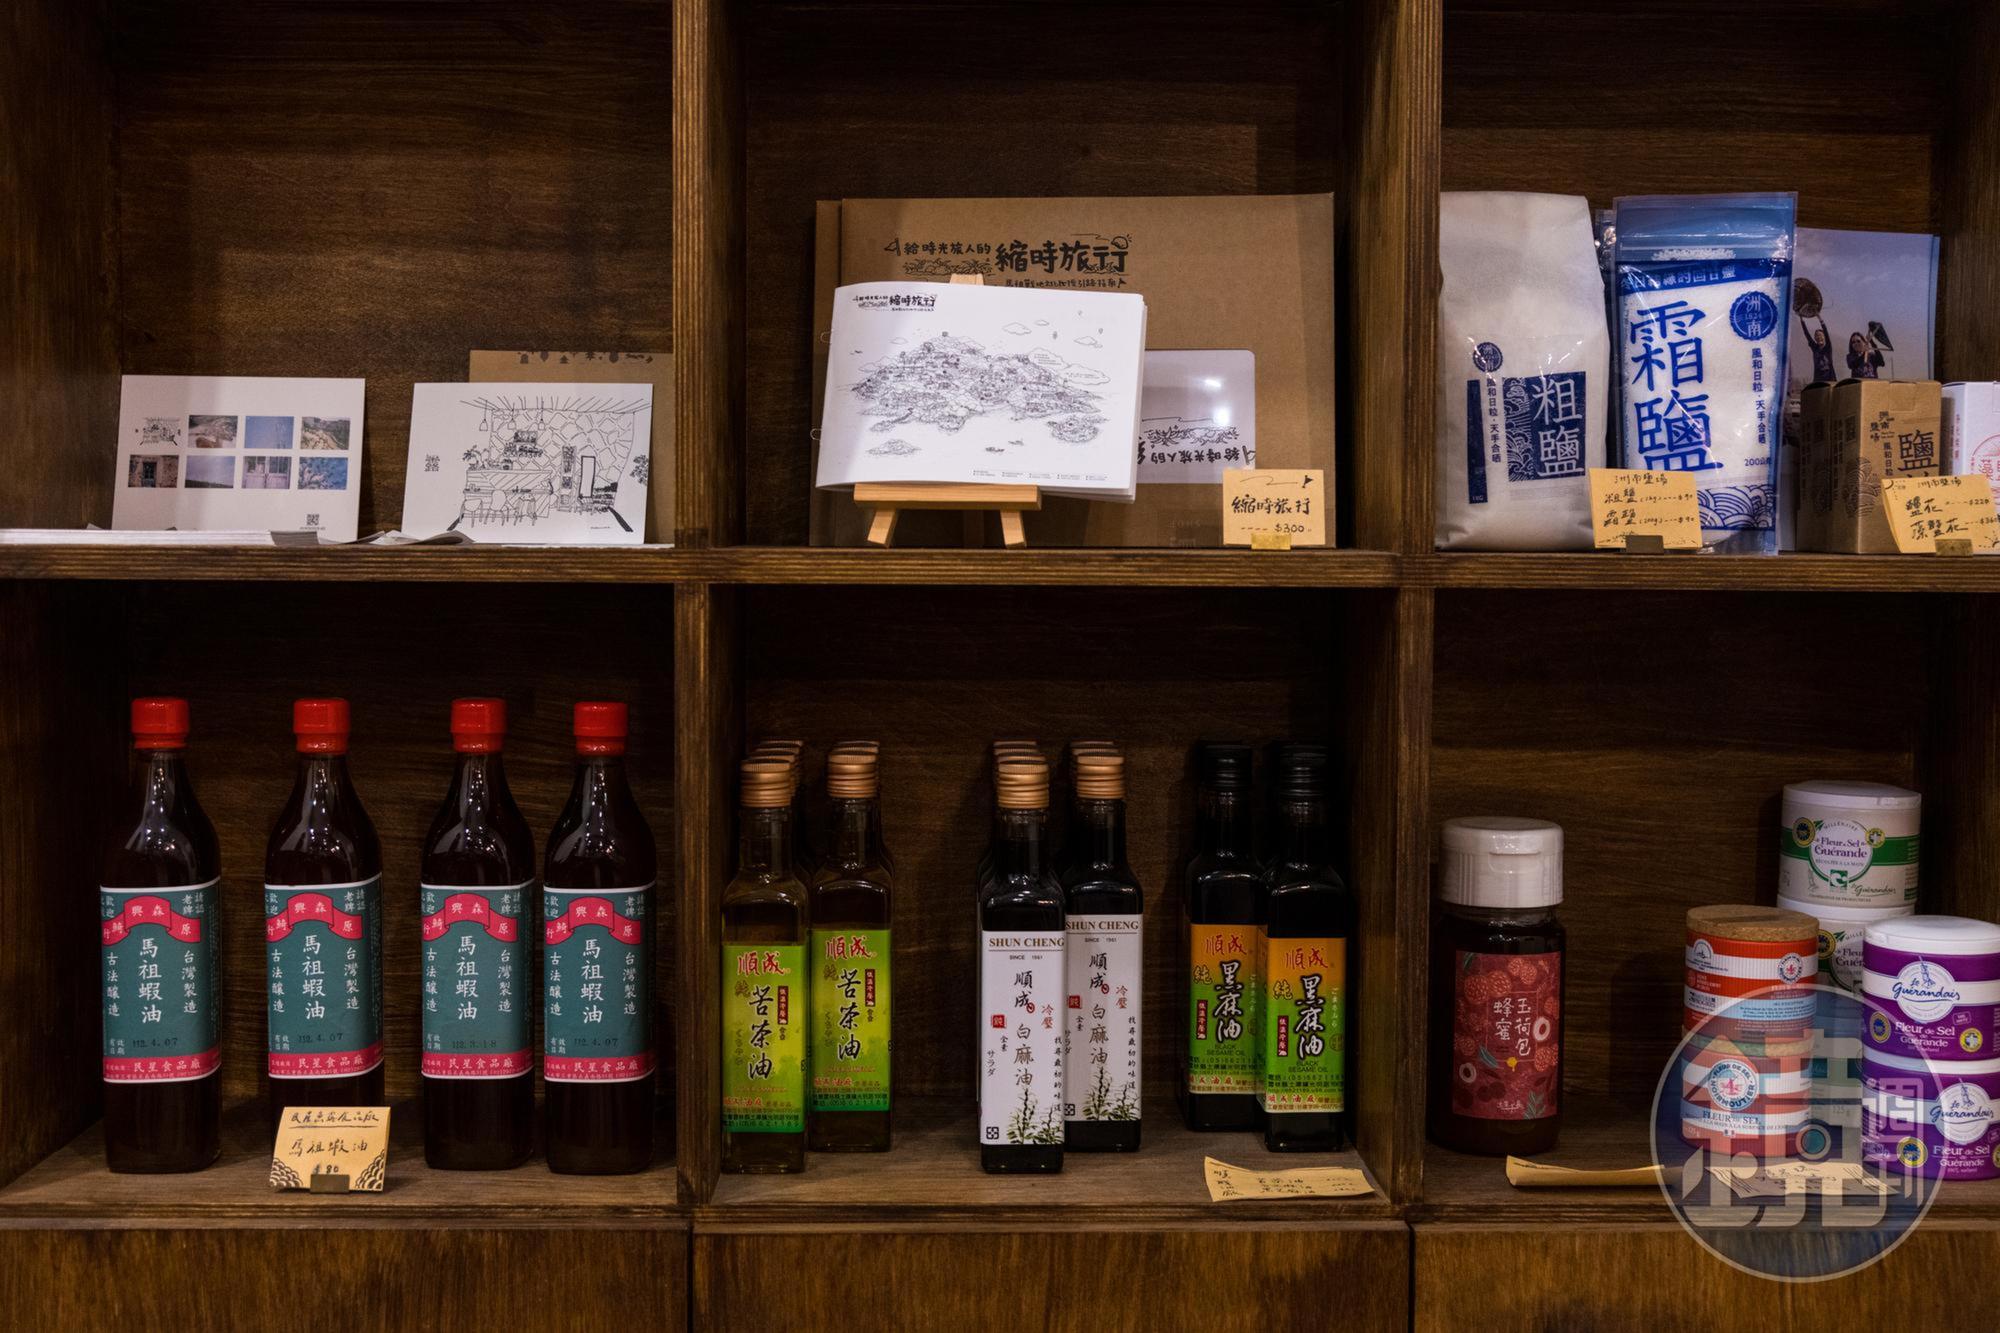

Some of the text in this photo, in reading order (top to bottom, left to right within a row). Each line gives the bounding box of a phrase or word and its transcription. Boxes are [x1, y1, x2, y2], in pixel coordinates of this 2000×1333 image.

[904, 239, 1129, 273] 給時光旅人的 縮時旅行
[1630, 300, 1723, 472] 霜鹽
[1532, 377, 1585, 478] 粗鹽
[1151, 447, 1240, 464] 給時光旅人的
[1897, 430, 1939, 478] 鹽
[1231, 493, 1311, 515] 縮時旅行
[1274, 523, 1305, 533] $300
[1814, 844, 1867, 858] Guérande
[1821, 836, 1860, 848] Fleur Sel
[1066, 920, 1139, 930] SHUN CHENG
[825, 935, 872, 960] 順成
[989, 937, 1065, 948] SHUN CHENG
[1206, 934, 1247, 956] 順成
[1843, 948, 1864, 956] Fleu
[737, 951, 784, 976] 順成
[1089, 952, 1107, 989] 順成
[1285, 947, 1329, 970] 順成
[1835, 955, 1864, 967] Guér
[107, 951, 121, 1018] 古法釀造
[138, 937, 164, 1024] 馬祖蝦油
[181, 949, 199, 1014] 台灣製造
[271, 949, 286, 1013] 古法釀造
[302, 934, 327, 1020] 馬祖蝦油
[344, 946, 360, 1010] 台灣製造
[426, 947, 439, 1013] 古法釀造
[455, 935, 480, 1020] 馬祖蝦油
[497, 949, 513, 1013] 台灣製造
[549, 952, 563, 1017] 古法釀造
[580, 938, 605, 1024] 馬祖蝦油
[622, 952, 638, 1016] 台灣製造
[1193, 963, 1213, 986] 純
[1014, 970, 1033, 1008] 順成
[1116, 985, 1128, 1009] 冷壓
[1213, 960, 1244, 1043] 黑麻油
[1272, 979, 1294, 1001] 純
[1892, 981, 1960, 1001] Guérandais
[837, 968, 861, 1060] 苦茶油
[1041, 1003, 1054, 1029] 冷壓
[1295, 973, 1326, 1061] 黑麻油
[1493, 996, 1515, 1041] 蜂蜜
[1515, 996, 1532, 1056] 玉荷包
[748, 985, 774, 1080] 苦茶油
[1089, 1004, 1109, 1065] 白麻油
[1895, 1021, 1924, 1034] Fleur
[1936, 1026, 1955, 1036] Sel
[1900, 1035, 1949, 1048] Guérande
[986, 1049, 997, 1076] サラダ
[1013, 1023, 1034, 1086] 白麻油
[1713, 1062, 1732, 1077] FLEUR
[1710, 1079, 1756, 1109] NOIRMOUTIER
[1703, 1110, 1762, 1125] FLEUR SEL
[1930, 1105, 1994, 1124] Guérandais
[289, 1138, 369, 1157] 馬祖蝦油
[1933, 1145, 1964, 1156] Fleur
[1975, 1144, 1991, 1155] Sel
[1940, 1158, 1985, 1167] Guérande
